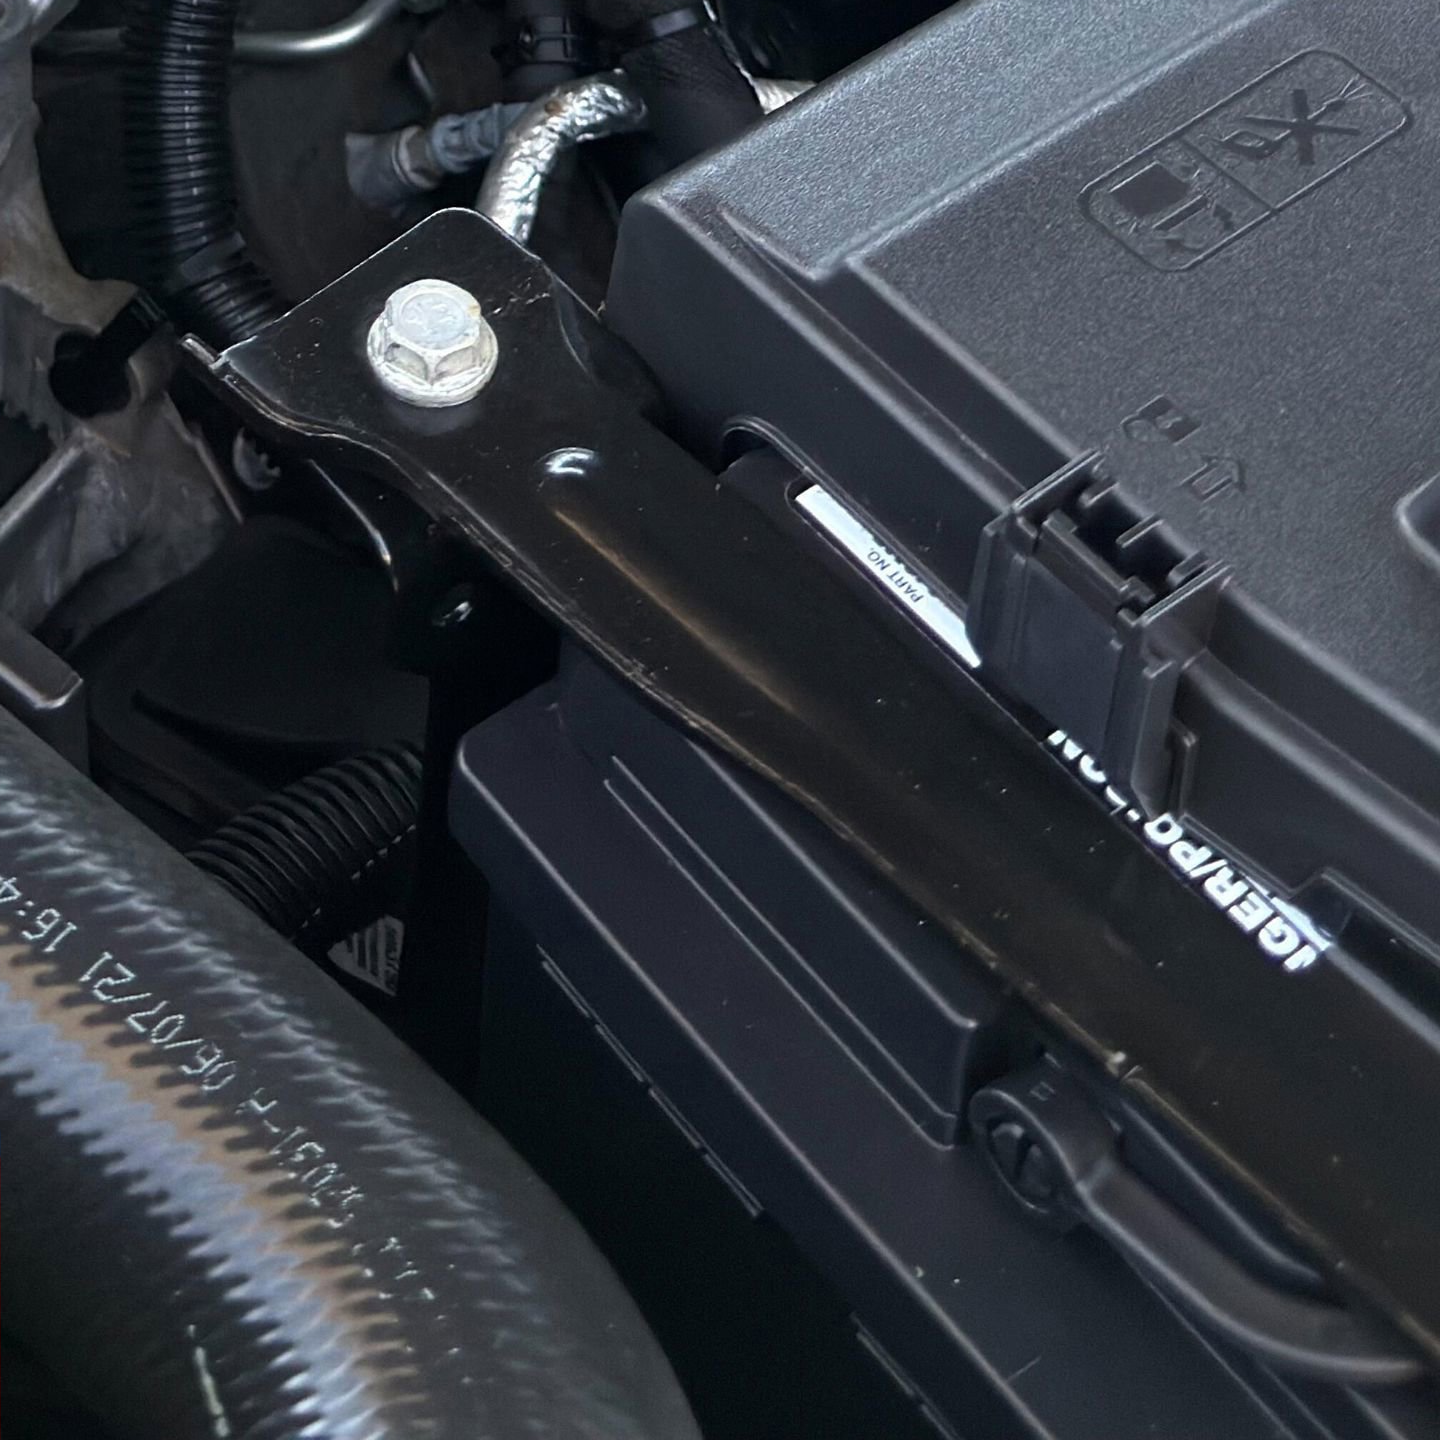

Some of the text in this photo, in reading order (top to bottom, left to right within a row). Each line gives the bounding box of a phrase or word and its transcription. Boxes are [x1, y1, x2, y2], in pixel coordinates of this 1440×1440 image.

[867, 547, 925, 604] PART NO.
[79, 952, 238, 1091] 06/07/21
